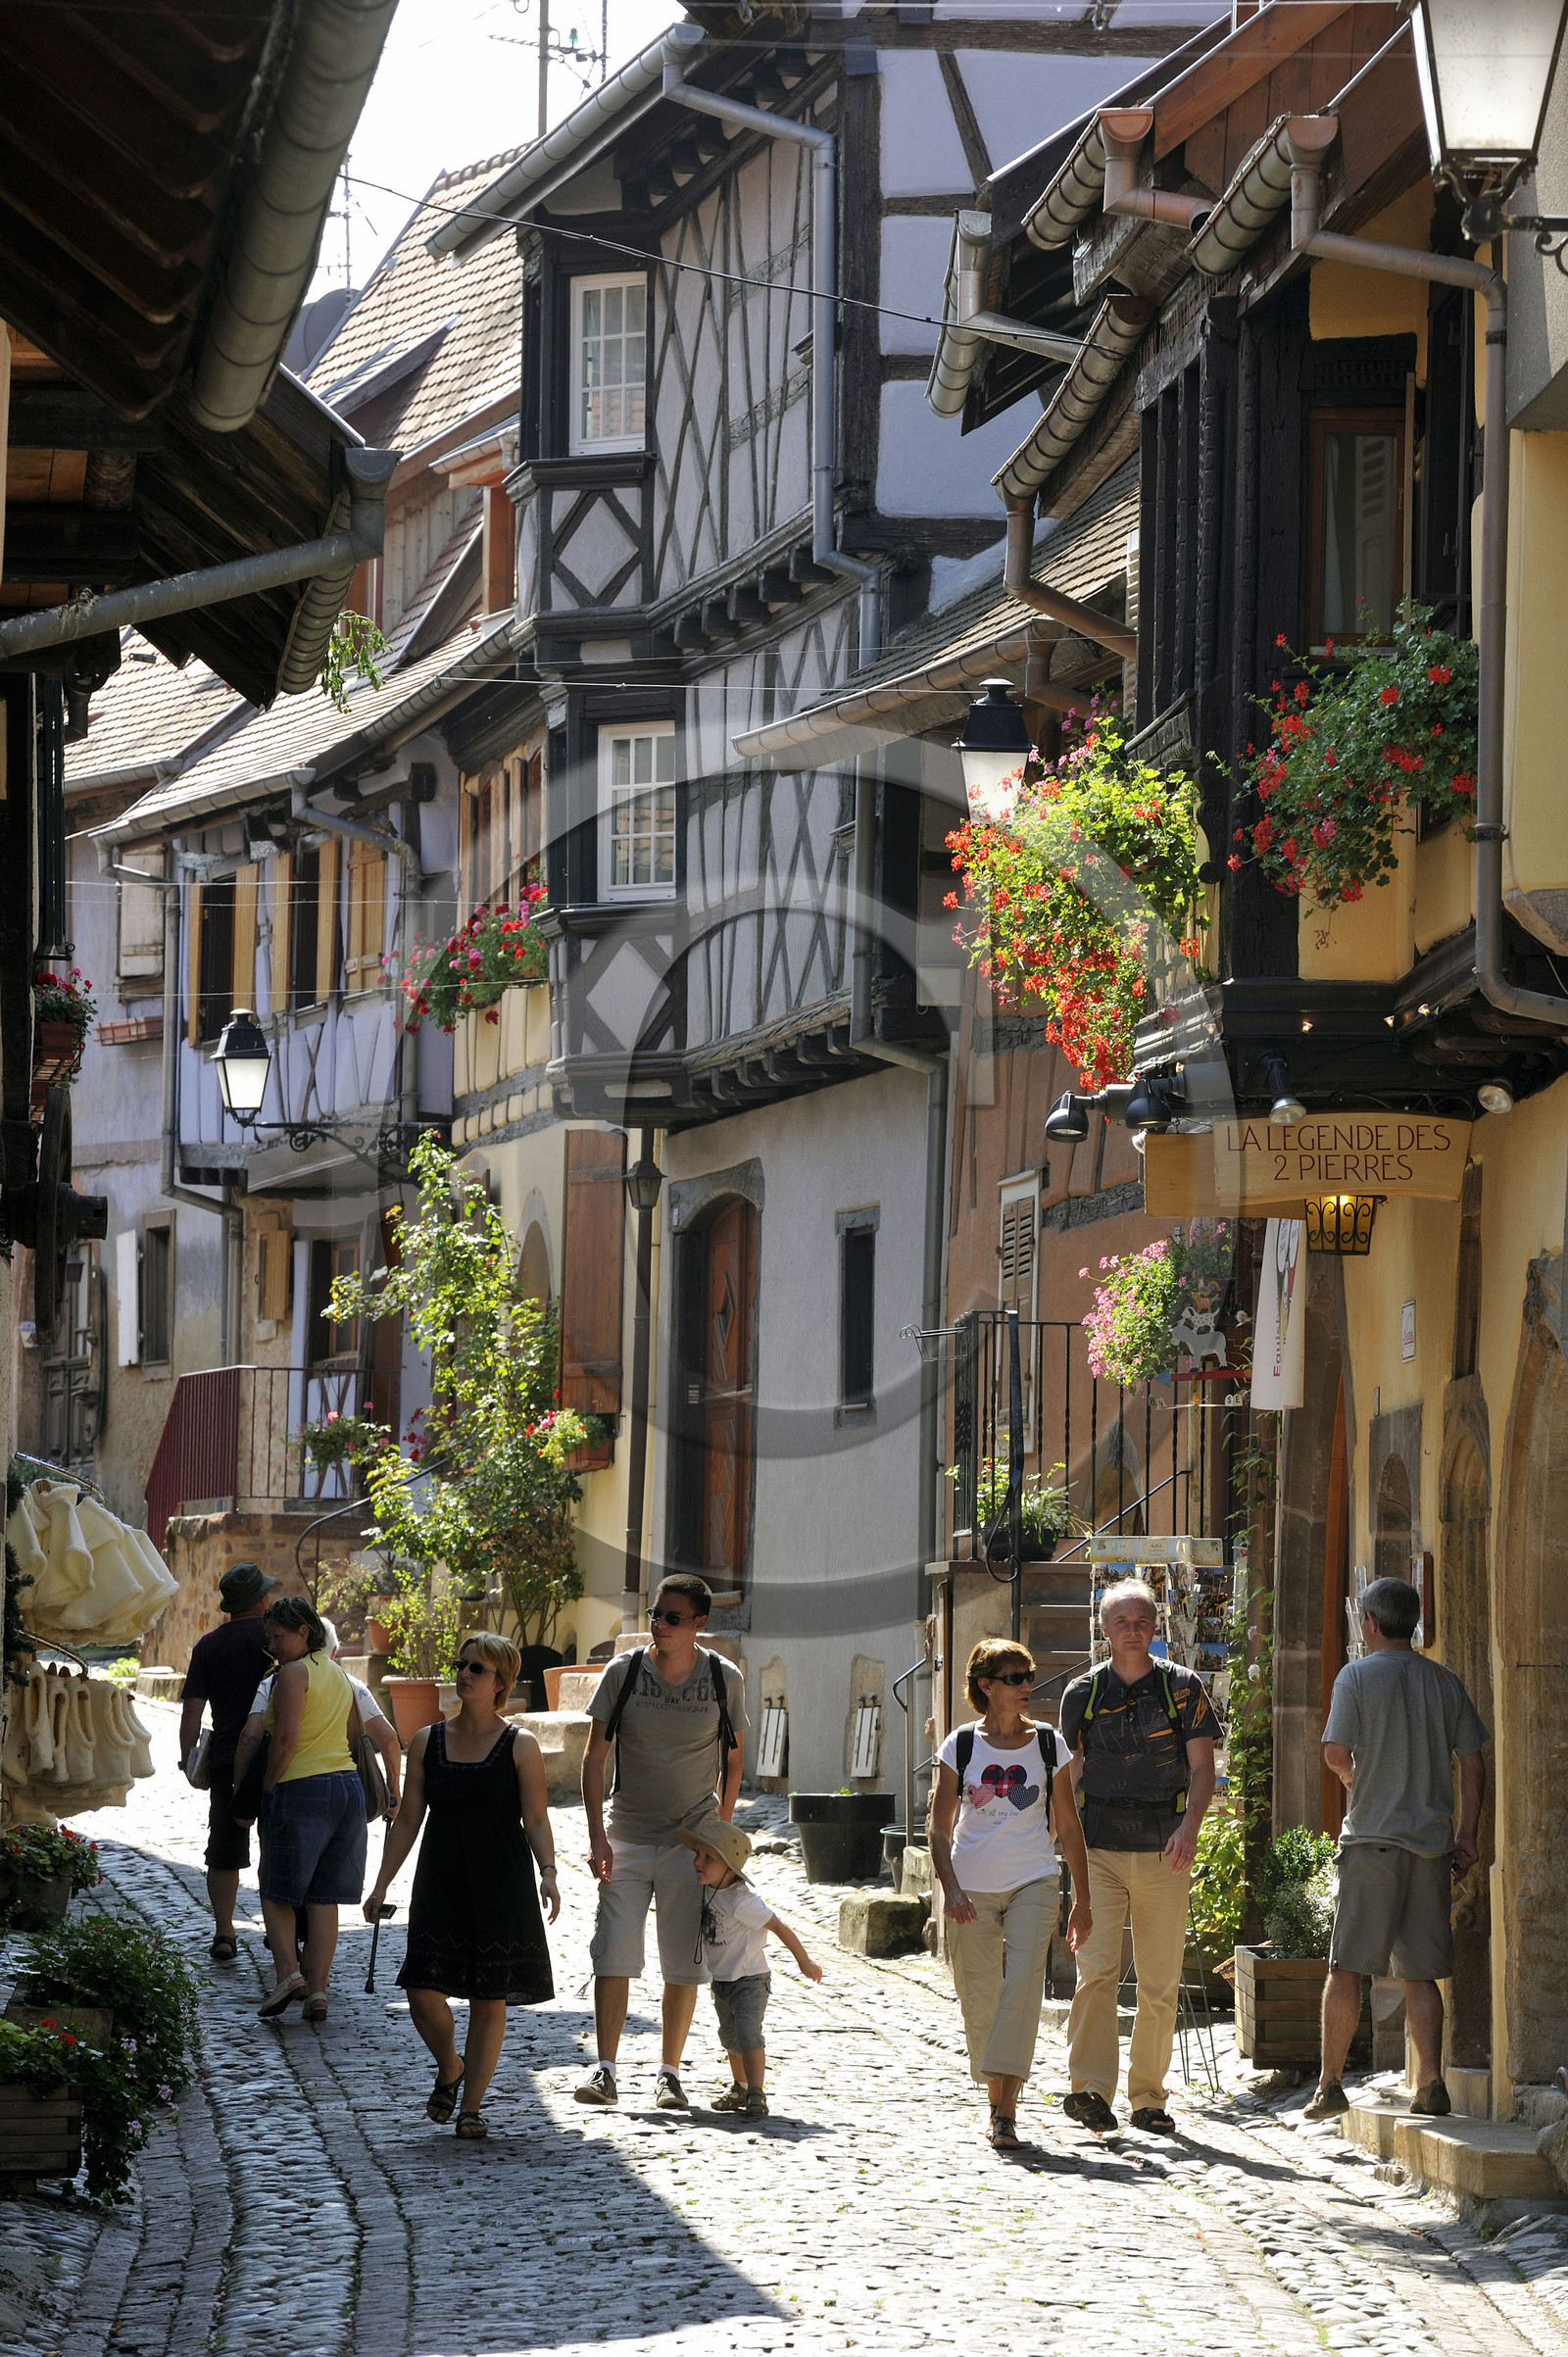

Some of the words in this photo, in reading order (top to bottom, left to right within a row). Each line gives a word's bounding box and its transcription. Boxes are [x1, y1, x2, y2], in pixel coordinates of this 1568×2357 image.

[1227, 1124, 1262, 1152] LA
[1267, 1124, 1392, 1152] LEGENDE
[1397, 1124, 1450, 1152] DES
[1274, 1154, 1290, 1181] 2
[1299, 1154, 1413, 1183] PIERRES
